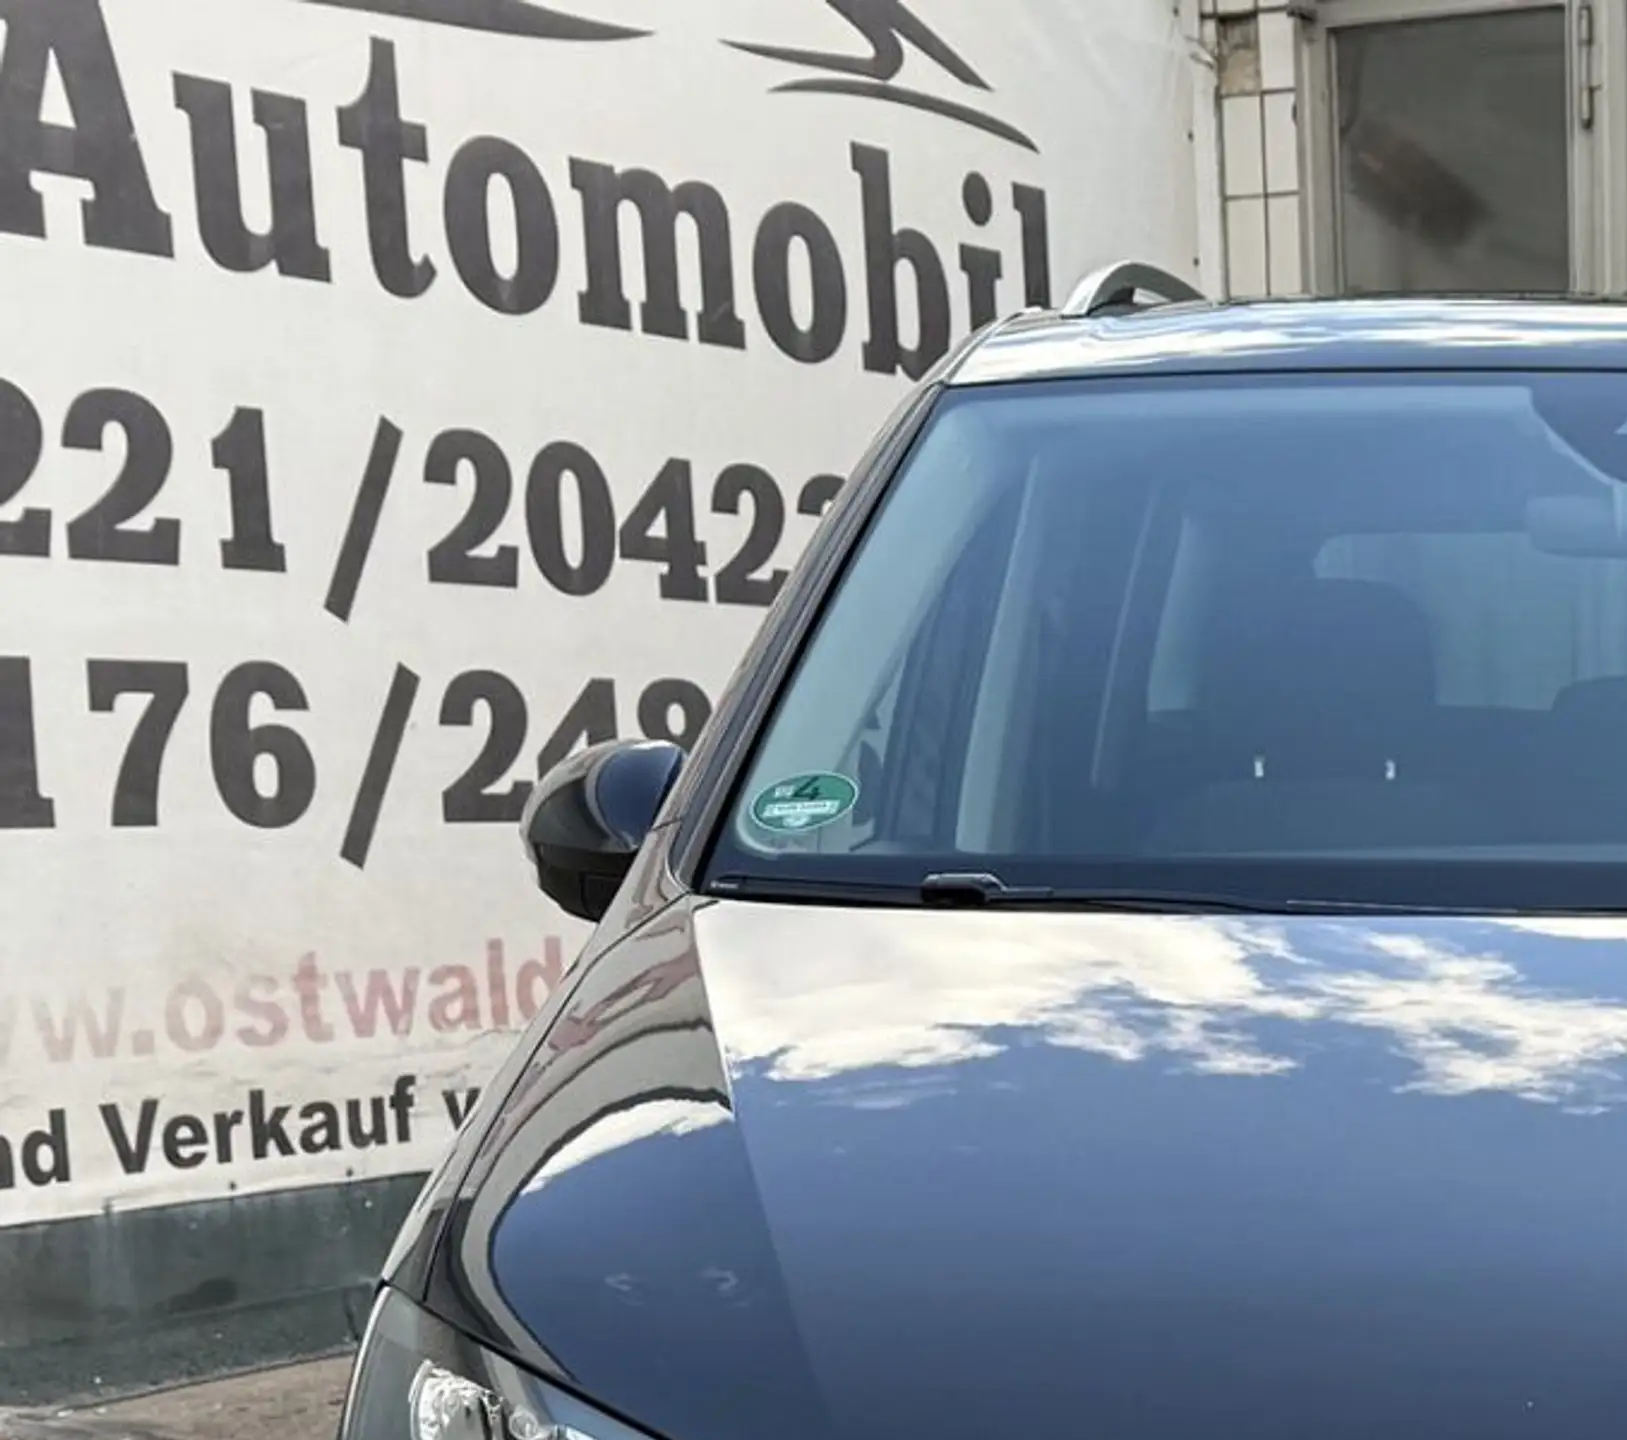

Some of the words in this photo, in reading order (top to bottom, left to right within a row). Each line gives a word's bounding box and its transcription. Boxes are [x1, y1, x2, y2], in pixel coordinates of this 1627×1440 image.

[0, 0, 1052, 382] Automobil
[0, 936, 564, 1063] w.ostwald
[0, 1108, 71, 1188] d
[98, 1074, 416, 1175] Verkauf
